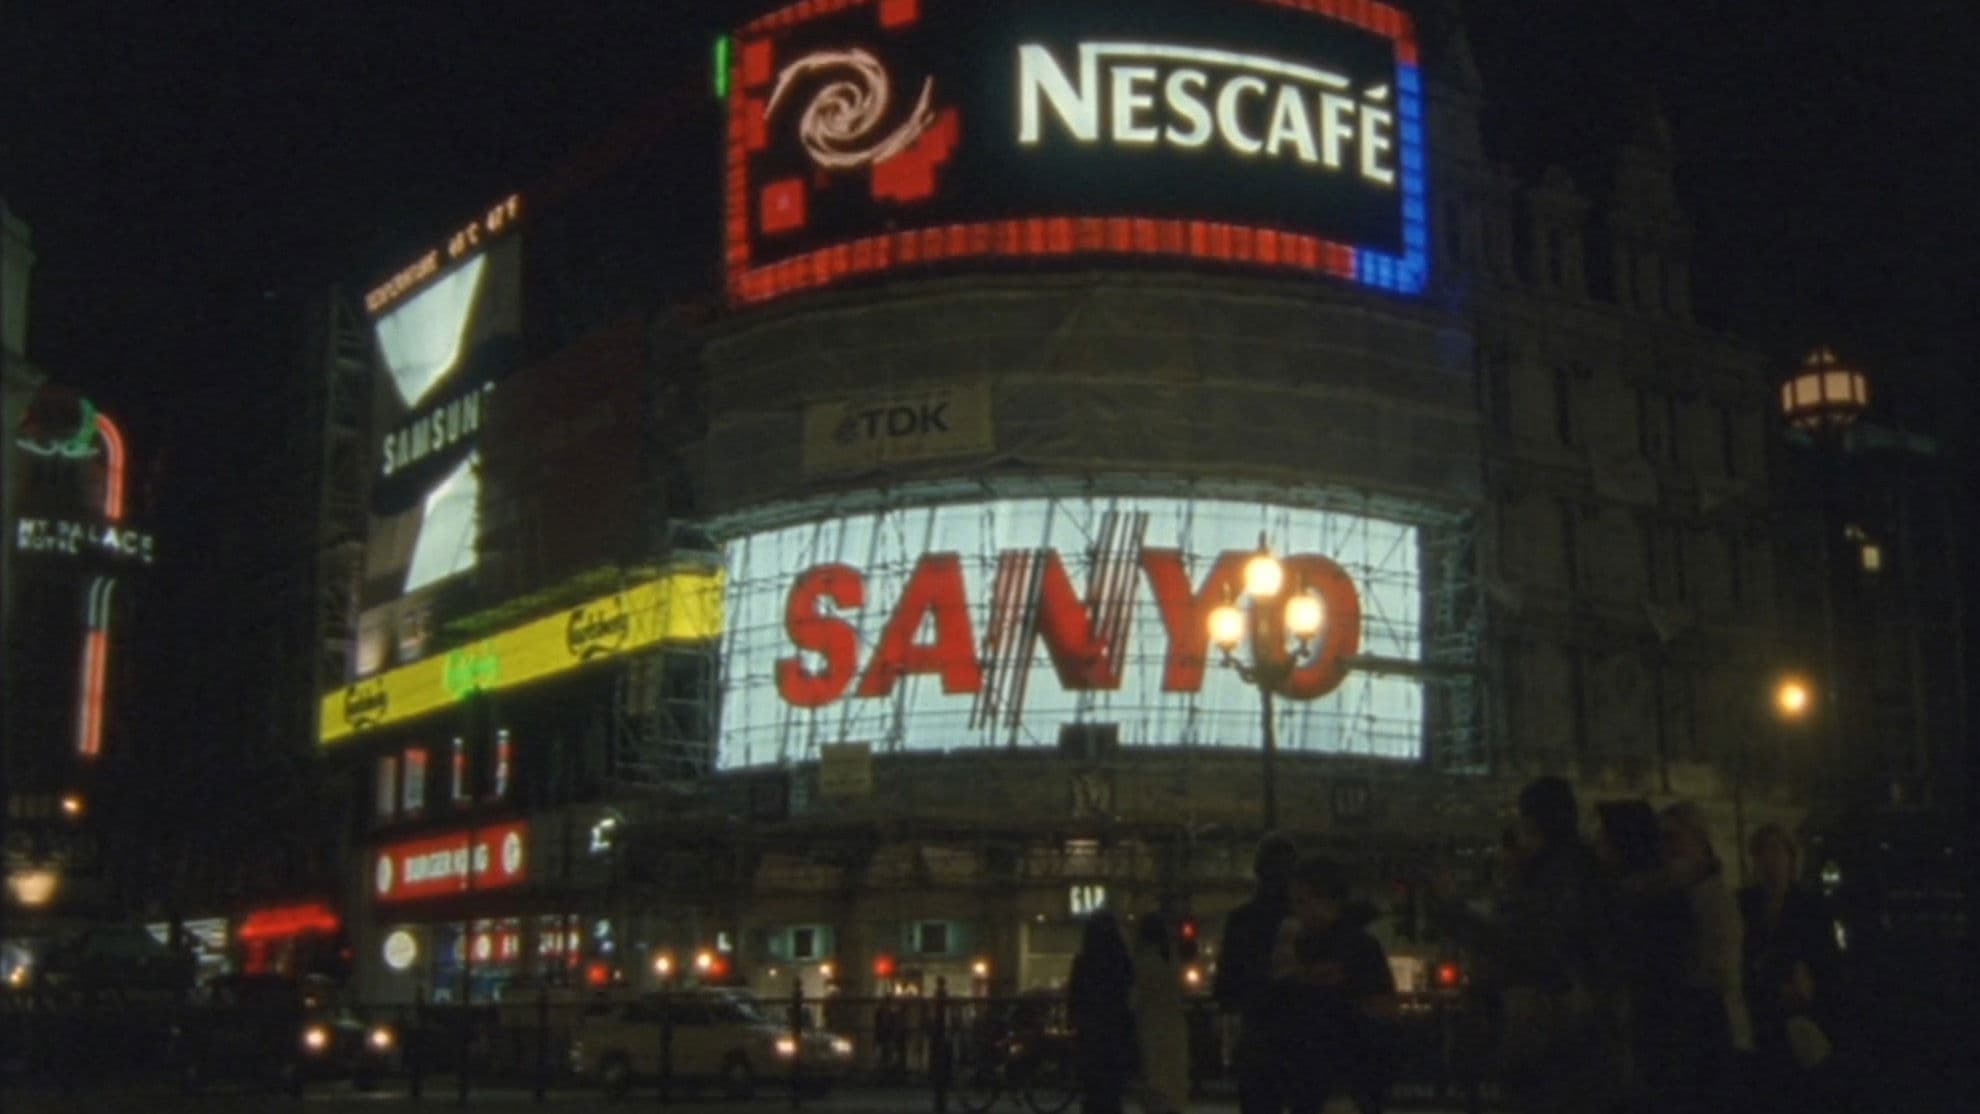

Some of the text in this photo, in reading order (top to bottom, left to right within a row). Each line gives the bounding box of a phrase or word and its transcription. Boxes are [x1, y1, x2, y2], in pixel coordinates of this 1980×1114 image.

[1018, 42, 1395, 184] NESCAFÉ
[382, 379, 496, 476] SAMSUN
[860, 402, 950, 438] TDK
[776, 512, 1362, 729] SANYO
